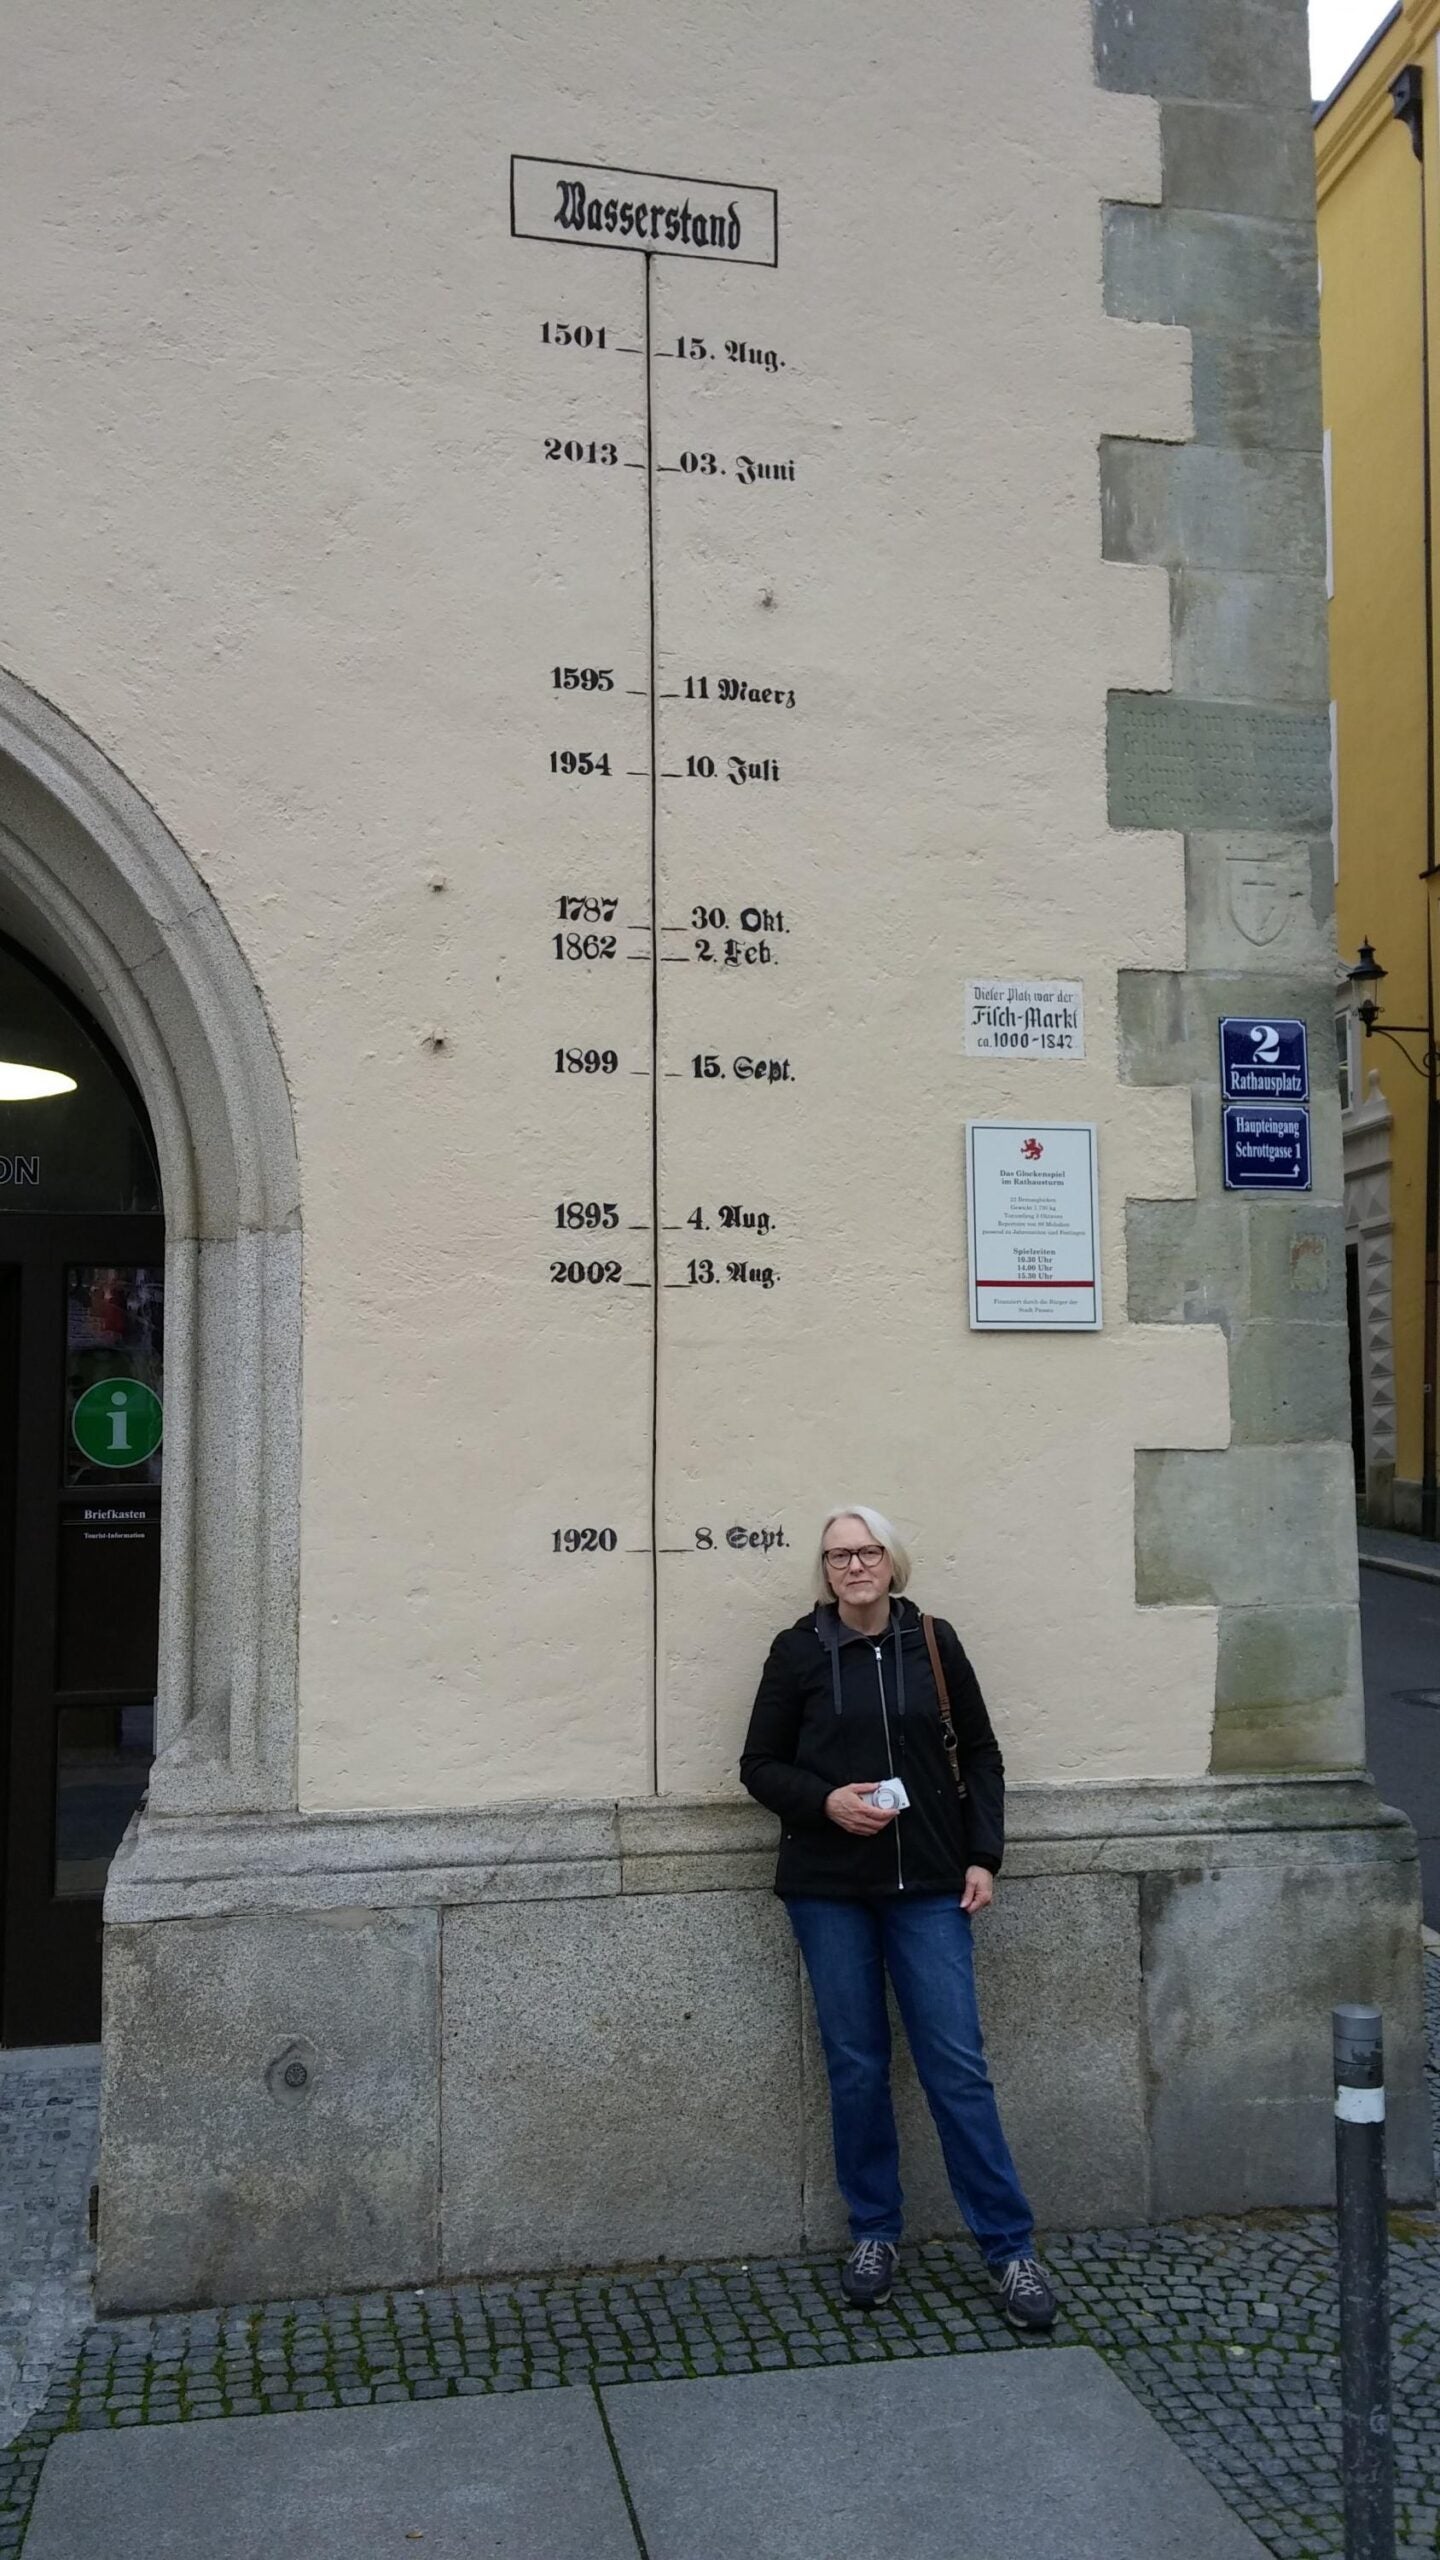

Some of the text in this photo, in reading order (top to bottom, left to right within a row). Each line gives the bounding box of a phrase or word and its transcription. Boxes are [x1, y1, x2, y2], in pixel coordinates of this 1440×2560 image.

[553, 180, 741, 251] Wasserstand
[542, 322, 785, 372] 1501 15. Aug.
[544, 439, 795, 484] 2013 03. Juni
[552, 667, 614, 691] 1595
[684, 676, 709, 699] 11
[550, 751, 779, 785] 1954 10. Juli
[556, 896, 790, 933] 1787 30. Okt.
[553, 933, 778, 967] 1862 2. Feb.
[1007, 988, 1031, 1003] Platz
[1034, 993, 1054, 1002] war
[1057, 990, 1073, 1003] der
[1250, 1025, 1280, 1063] 2
[555, 1048, 795, 1084] 1899 15. Sept.
[1230, 1071, 1302, 1096] Rathausplatz
[1236, 1115, 1300, 1138] Haupteingang
[1236, 1141, 1301, 1162] Schrottgasse 1
[1014, 1178, 1065, 1186] Rathausturm
[1016, 1170, 1065, 1179] Glockenspiel
[555, 1202, 775, 1235] 1895 4. Aug.
[1013, 1248, 1056, 1256] Spielzeiten
[550, 1259, 780, 1289] 2002 13. Aug.
[85, 1510, 145, 1519] Briefkasten
[553, 1526, 789, 1553] 1920 8. Sept.
